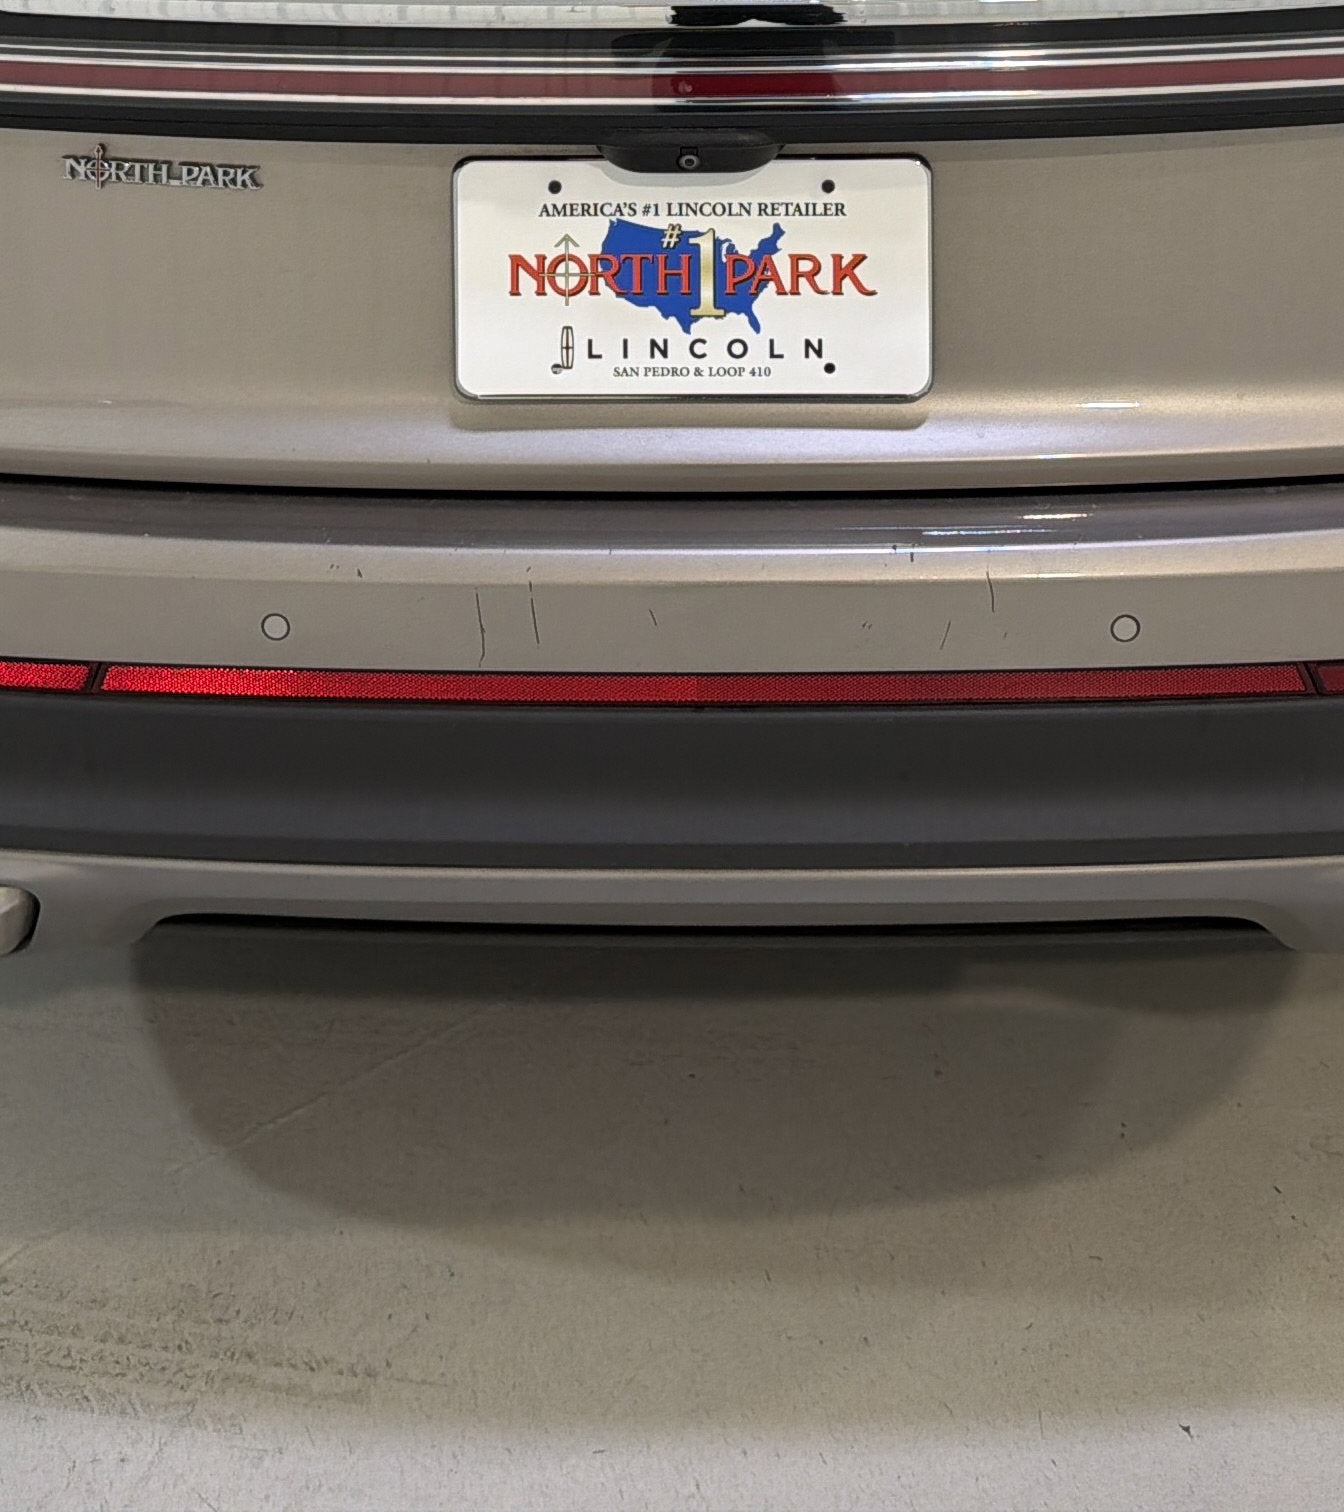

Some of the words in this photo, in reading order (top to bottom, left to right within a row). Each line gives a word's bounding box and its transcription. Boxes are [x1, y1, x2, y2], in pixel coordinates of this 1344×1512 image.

[62, 152, 169, 186] NORTH
[179, 162, 262, 189] PARK
[538, 201, 638, 218] AMERICA'S
[641, 202, 661, 218] #1
[666, 201, 753, 218] LINCOLN
[756, 201, 848, 218] RETAILER
[508, 252, 693, 297] NORTH
[724, 252, 879, 297] PARK
[587, 337, 824, 360] LINCOLN
[612, 365, 639, 378] SAN
[642, 365, 690, 378] PEDRO
[692, 365, 705, 378] &
[707, 365, 746, 378] LOOP
[748, 365, 772, 378] 410
